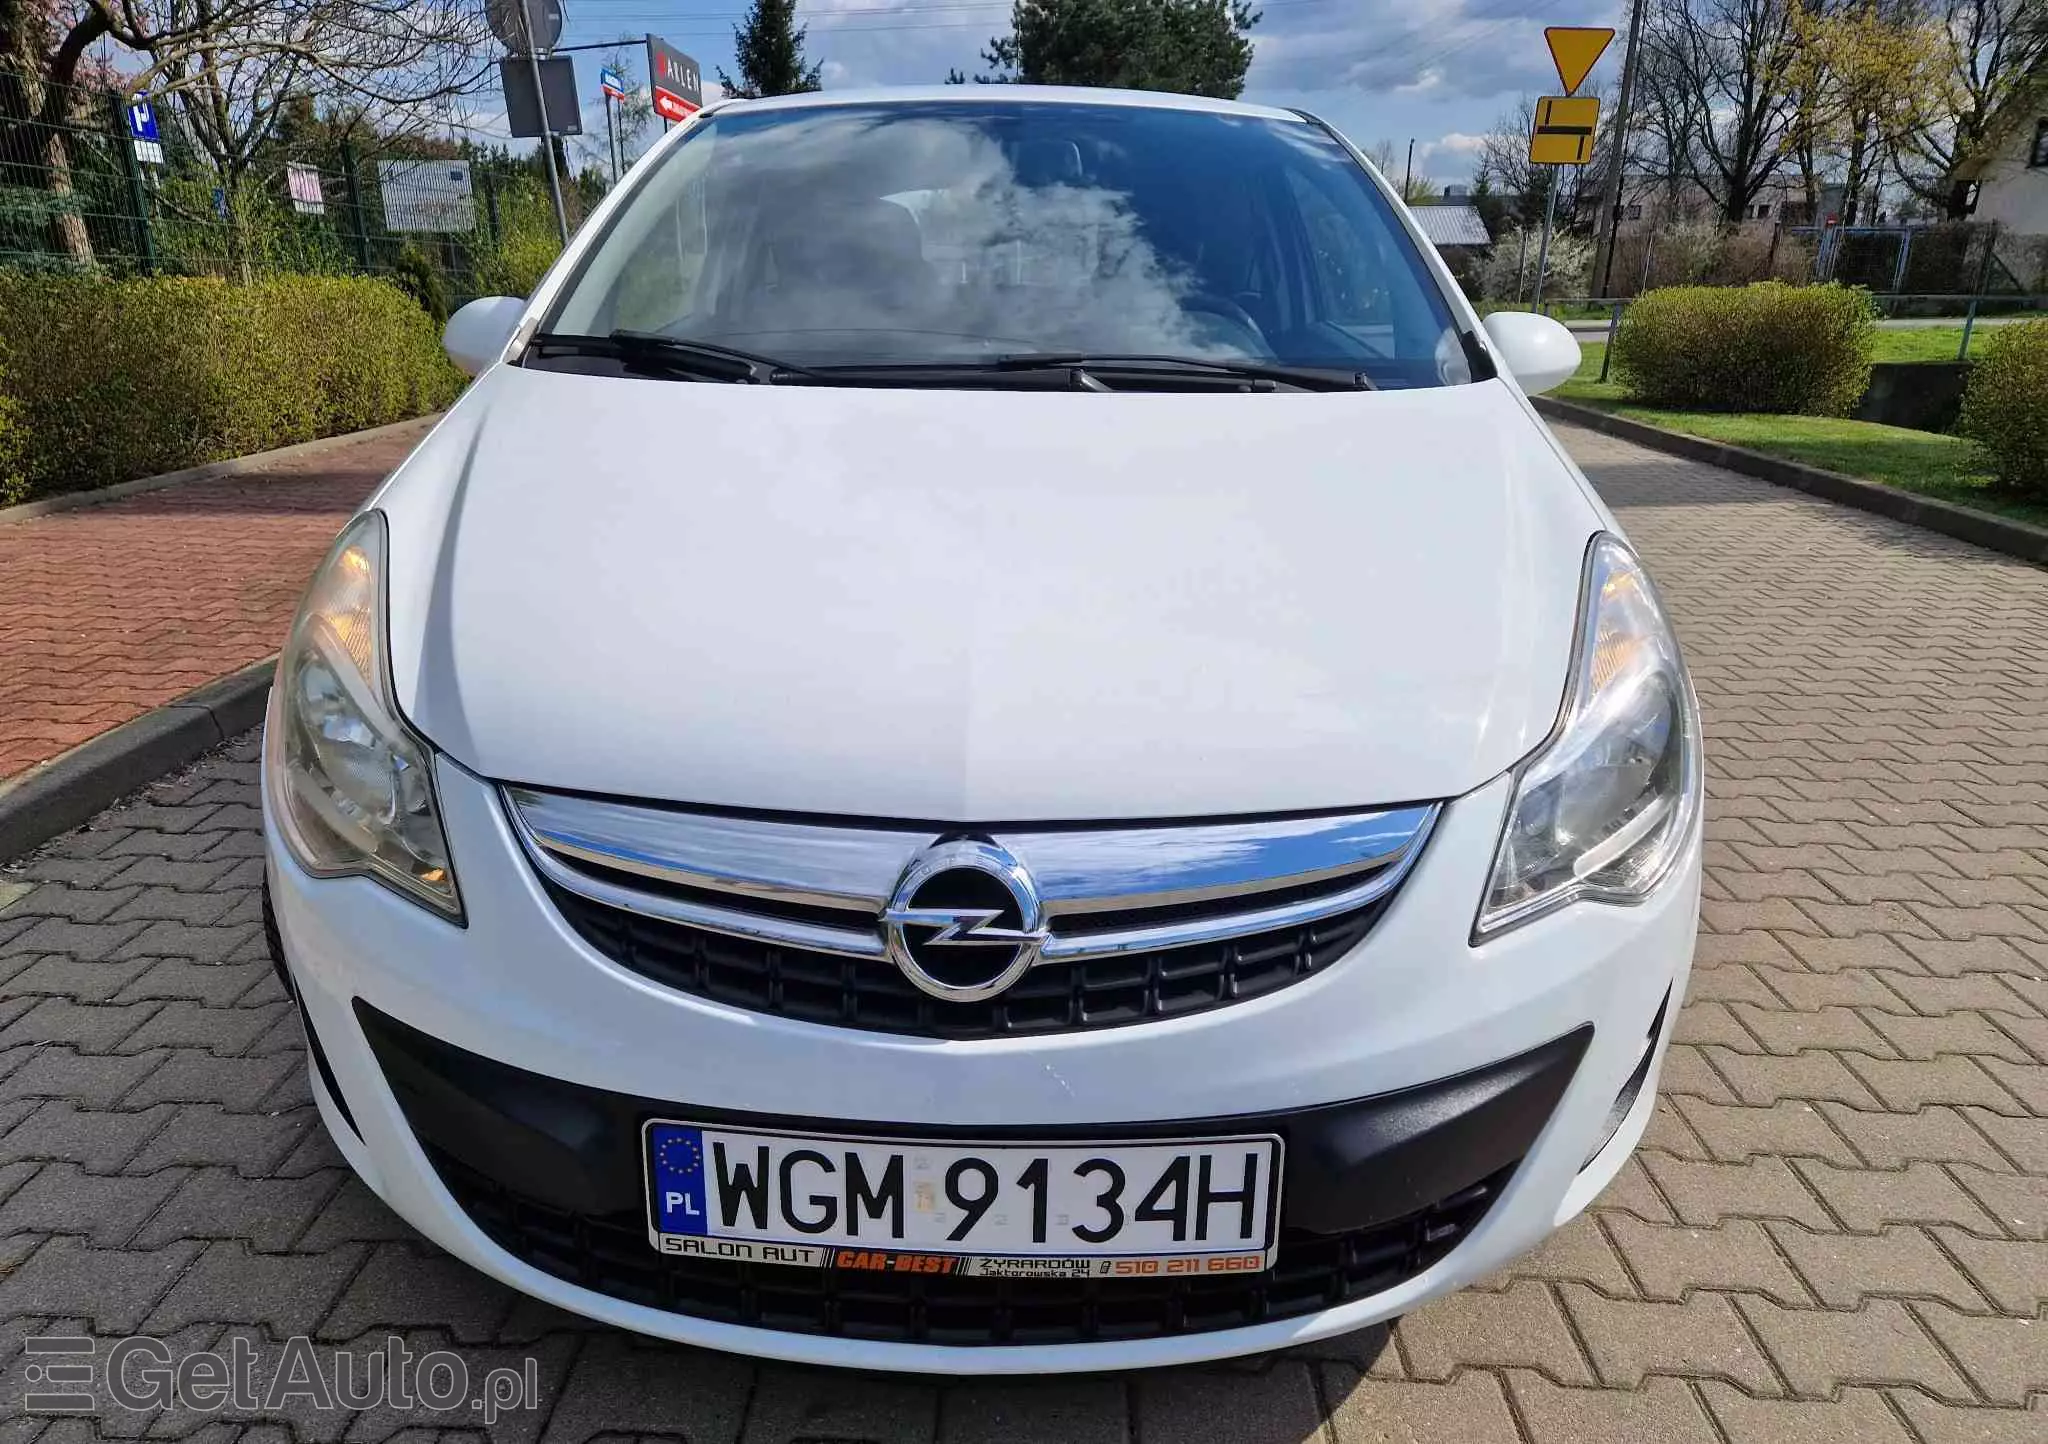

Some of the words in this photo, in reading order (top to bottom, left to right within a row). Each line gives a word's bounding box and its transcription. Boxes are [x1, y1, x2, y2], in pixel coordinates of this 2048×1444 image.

[665, 1191, 700, 1215] PL
[712, 1141, 904, 1240] WGM
[944, 1152, 1259, 1244] 9134H
[665, 1237, 753, 1259] SALON
[762, 1246, 815, 1263] AUT
[836, 1250, 959, 1274] CAR-BEST
[1071, 1268, 1091, 1279] 24
[1115, 1260, 1159, 1274] 510
[1167, 1258, 1200, 1273] 211
[1207, 1255, 1260, 1272] 660
